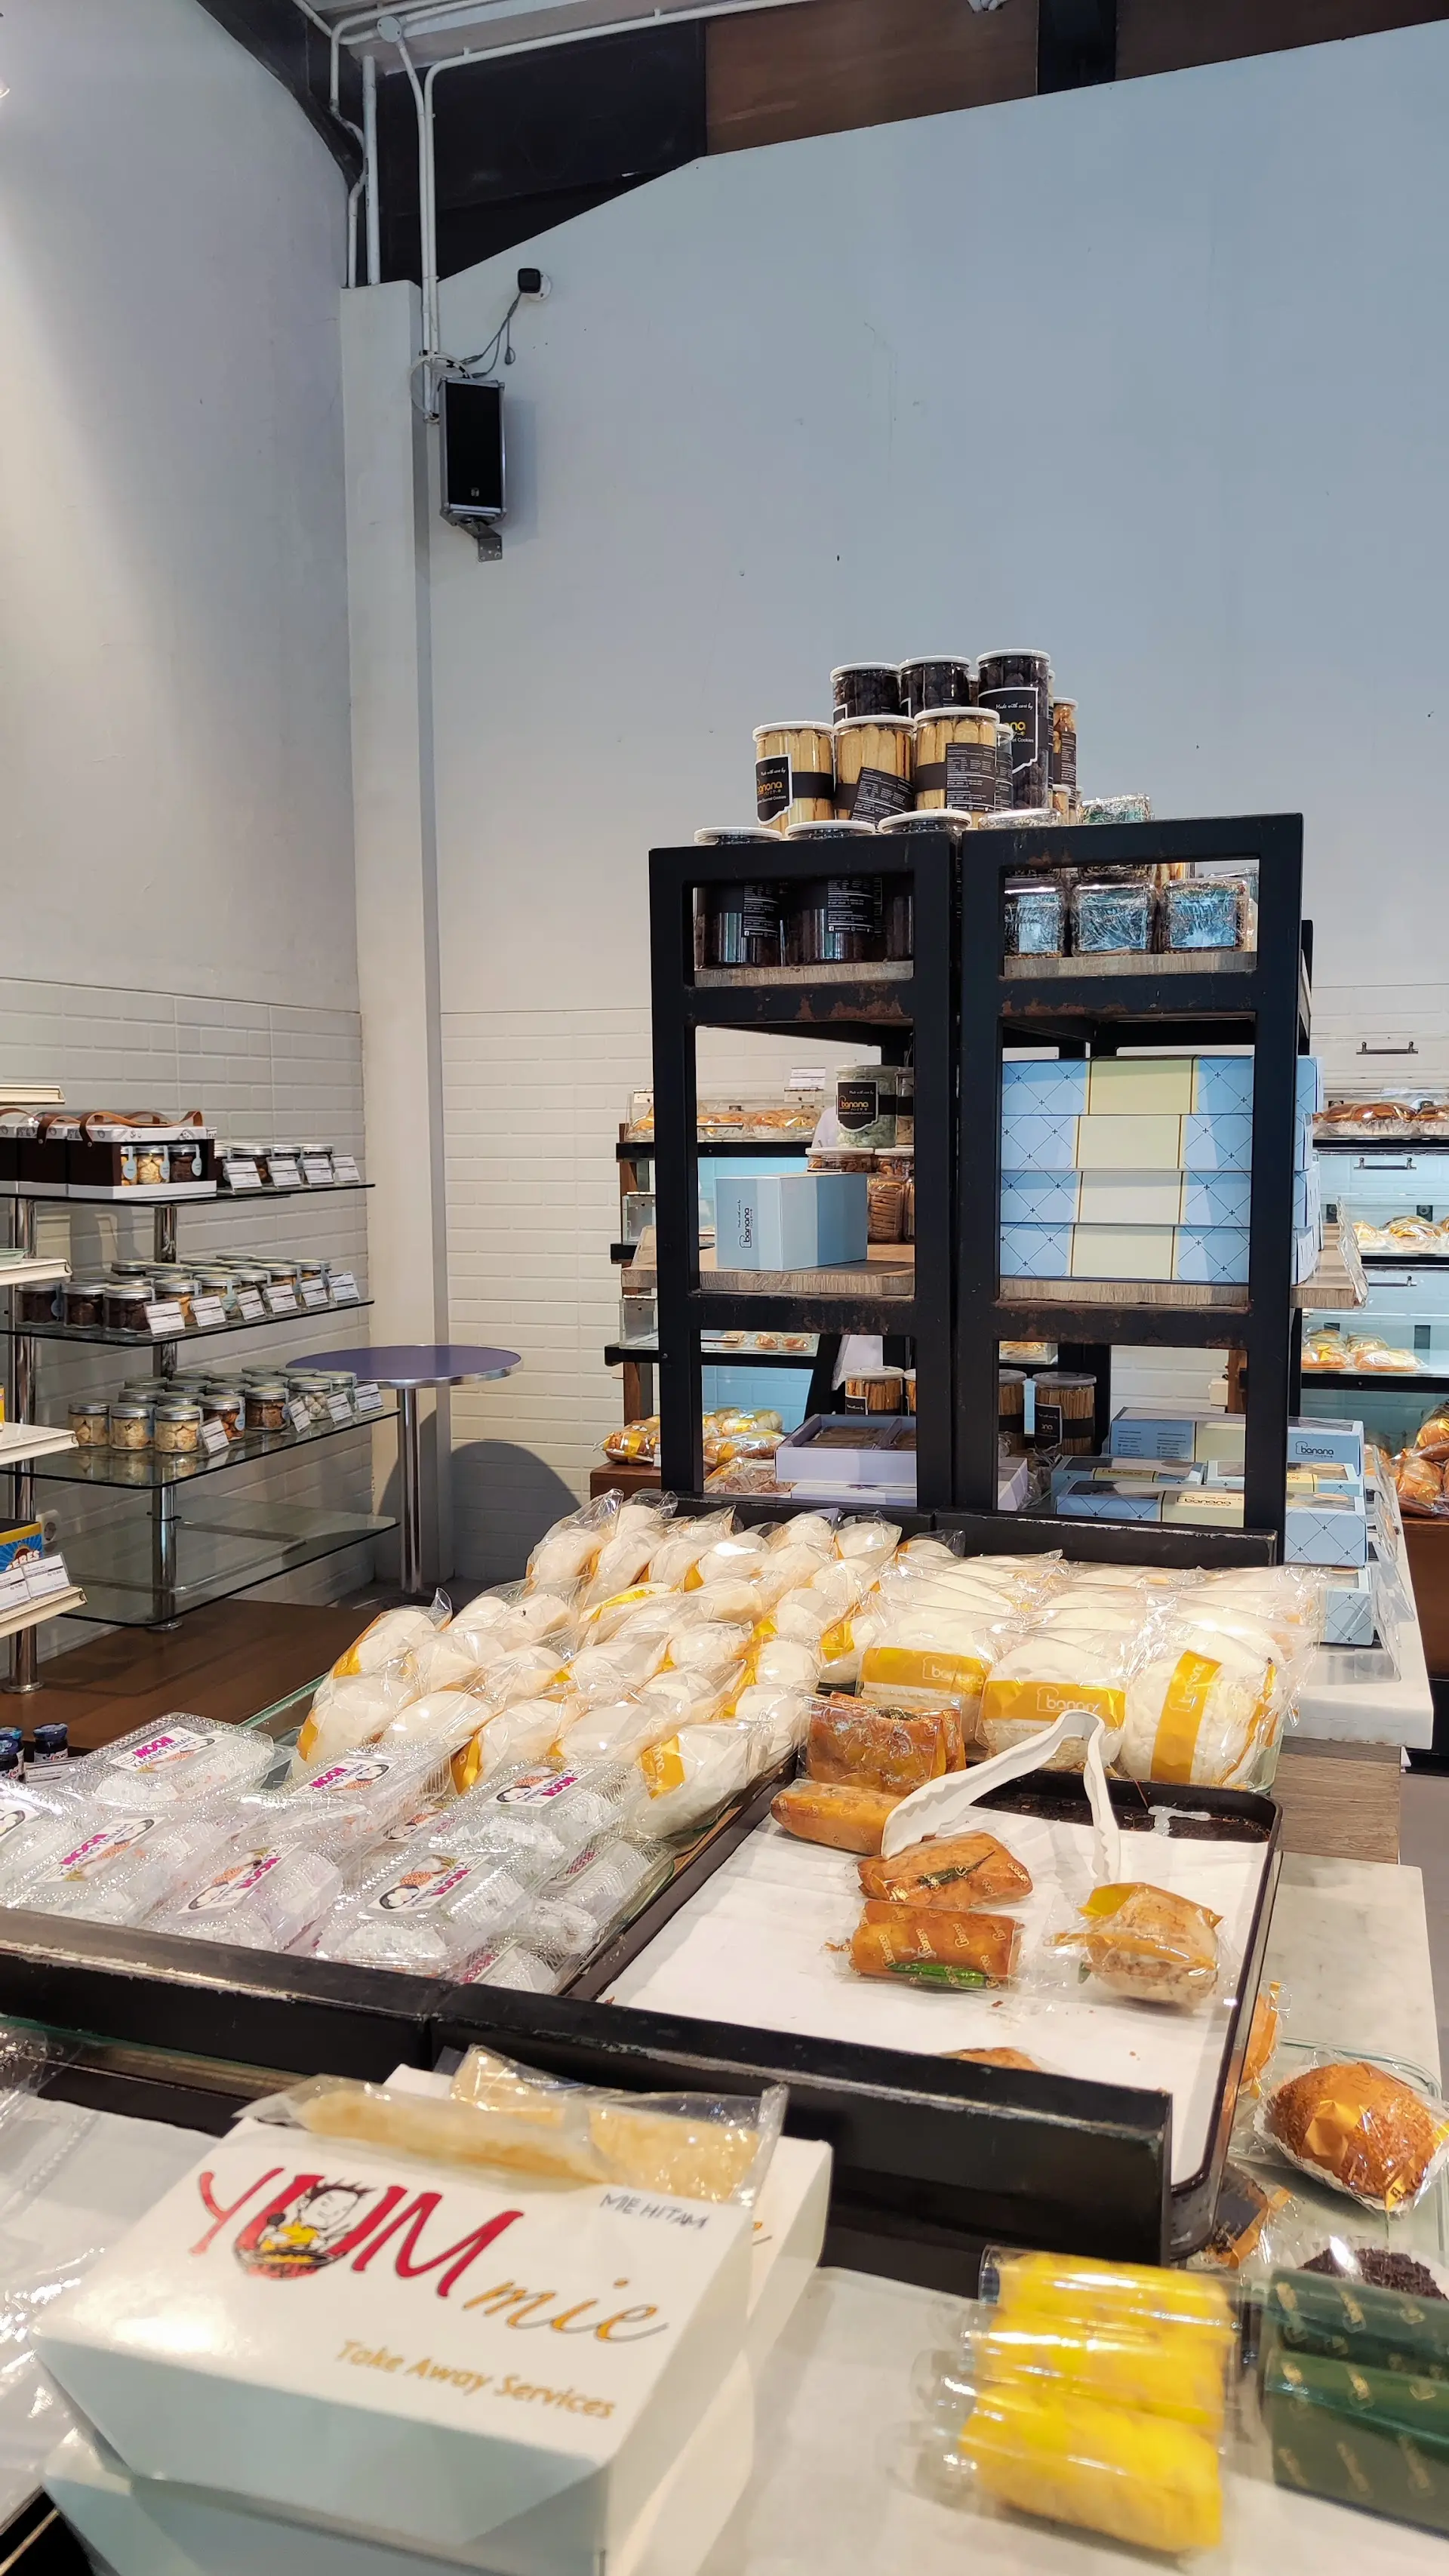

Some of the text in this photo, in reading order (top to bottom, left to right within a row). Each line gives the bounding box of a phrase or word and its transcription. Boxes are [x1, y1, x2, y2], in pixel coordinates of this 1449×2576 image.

[841, 1100, 869, 1108] banana
[1300, 1445, 1334, 1455] banana
[1184, 1497, 1232, 1507] banana
[1046, 1694, 1100, 1714] banan
[131, 1735, 175, 1759] MOCHI
[131, 1735, 195, 1768] KACANG TANAH
[308, 1767, 348, 1789] MOCHI
[343, 1762, 367, 1779] TANAH
[58, 1833, 109, 1866] MOCHI
[599, 2193, 710, 2230] MIE HITAM
[461, 2278, 669, 2342] mie
[335, 2340, 617, 2421] Take Away Services
